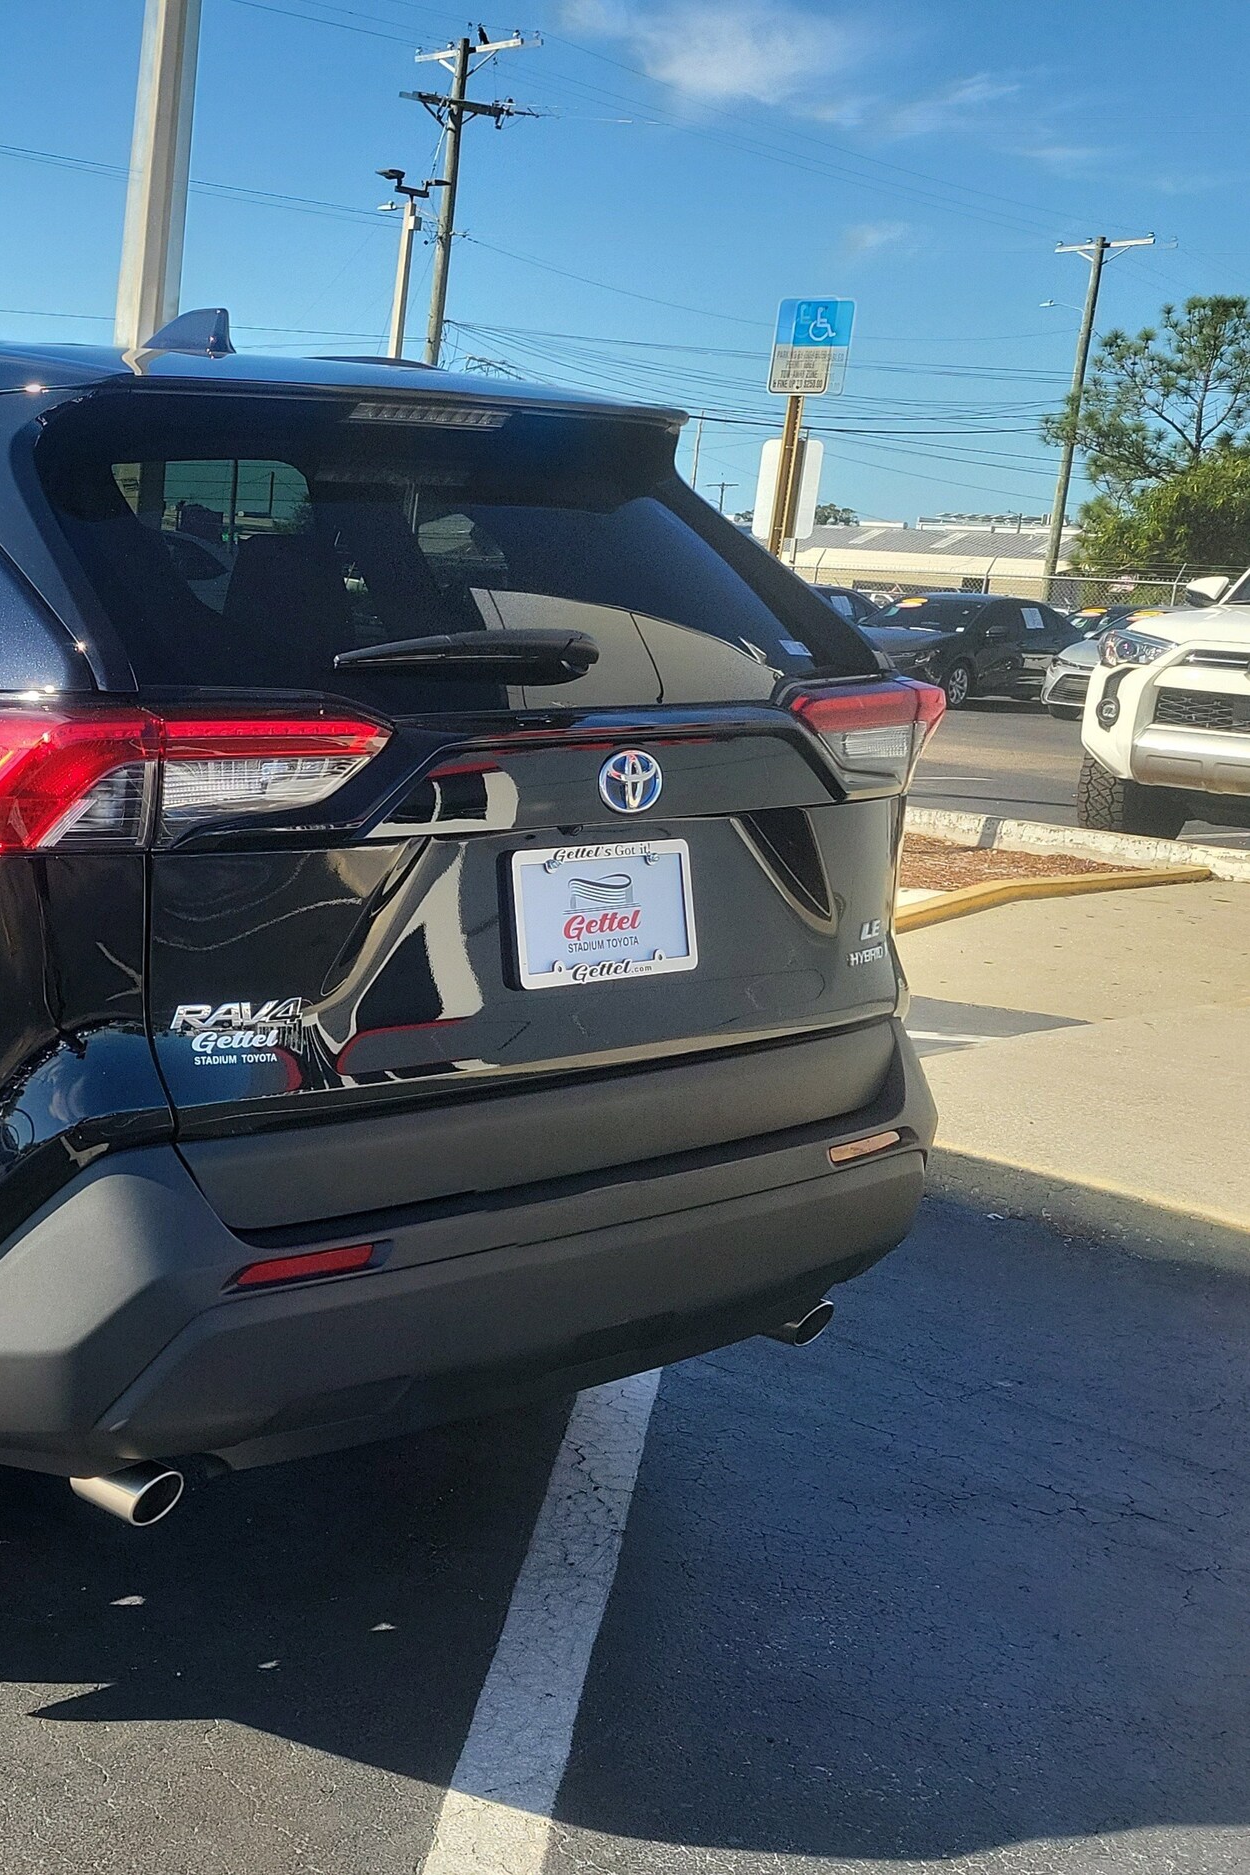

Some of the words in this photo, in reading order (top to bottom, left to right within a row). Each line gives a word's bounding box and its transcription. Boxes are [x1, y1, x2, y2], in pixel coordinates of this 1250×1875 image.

[553, 846, 611, 862] Gettel's
[615, 844, 635, 856] Got
[563, 909, 641, 941] Gettel
[860, 919, 881, 941] LE
[568, 940, 605, 953] STADIUM
[607, 936, 639, 948] TOYOTA
[848, 946, 884, 966] HYBRID
[572, 961, 653, 982] Gettel.com
[170, 996, 302, 1030] RAV4
[191, 1030, 279, 1053] Gettel
[194, 1054, 237, 1065] STADIUM
[242, 1053, 277, 1064] TOYOTA
